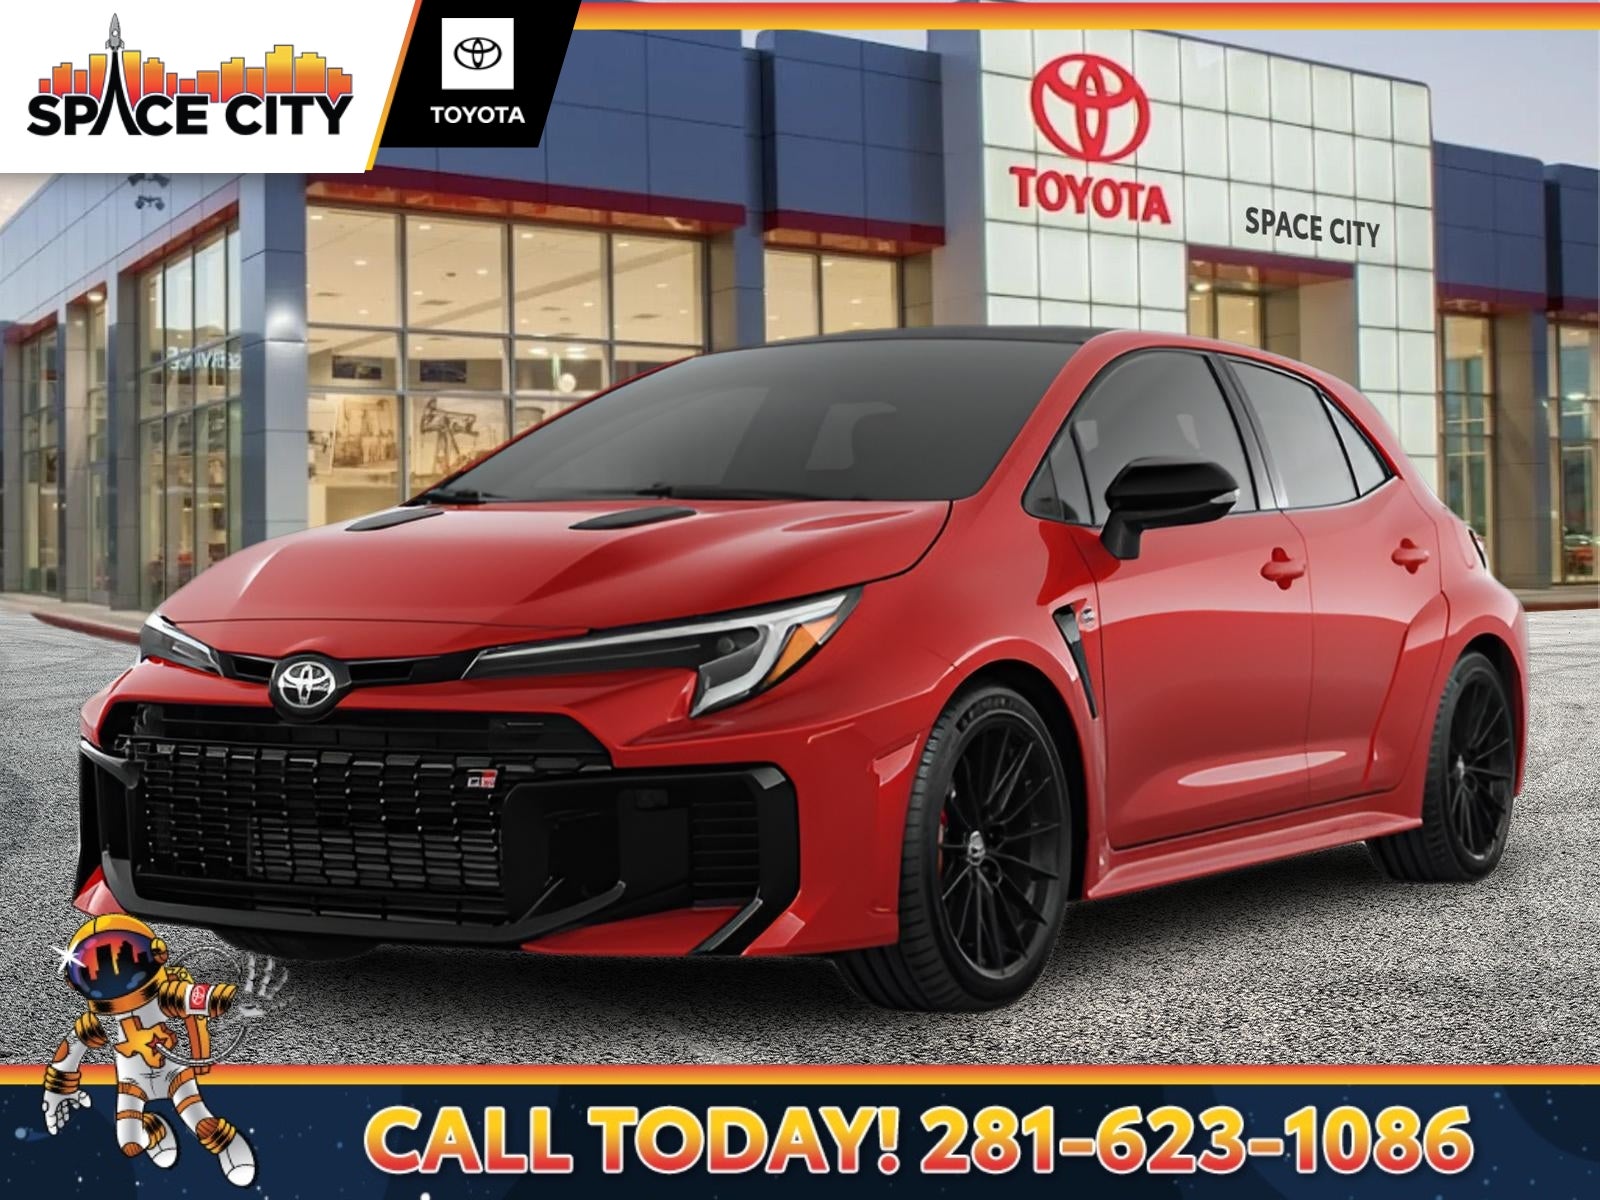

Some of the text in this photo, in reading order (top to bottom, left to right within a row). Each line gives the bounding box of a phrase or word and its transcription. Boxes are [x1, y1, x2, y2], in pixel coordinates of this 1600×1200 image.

[1009, 166, 1171, 224] TOYOTA
[1245, 206, 1381, 248] SPACE CITY
